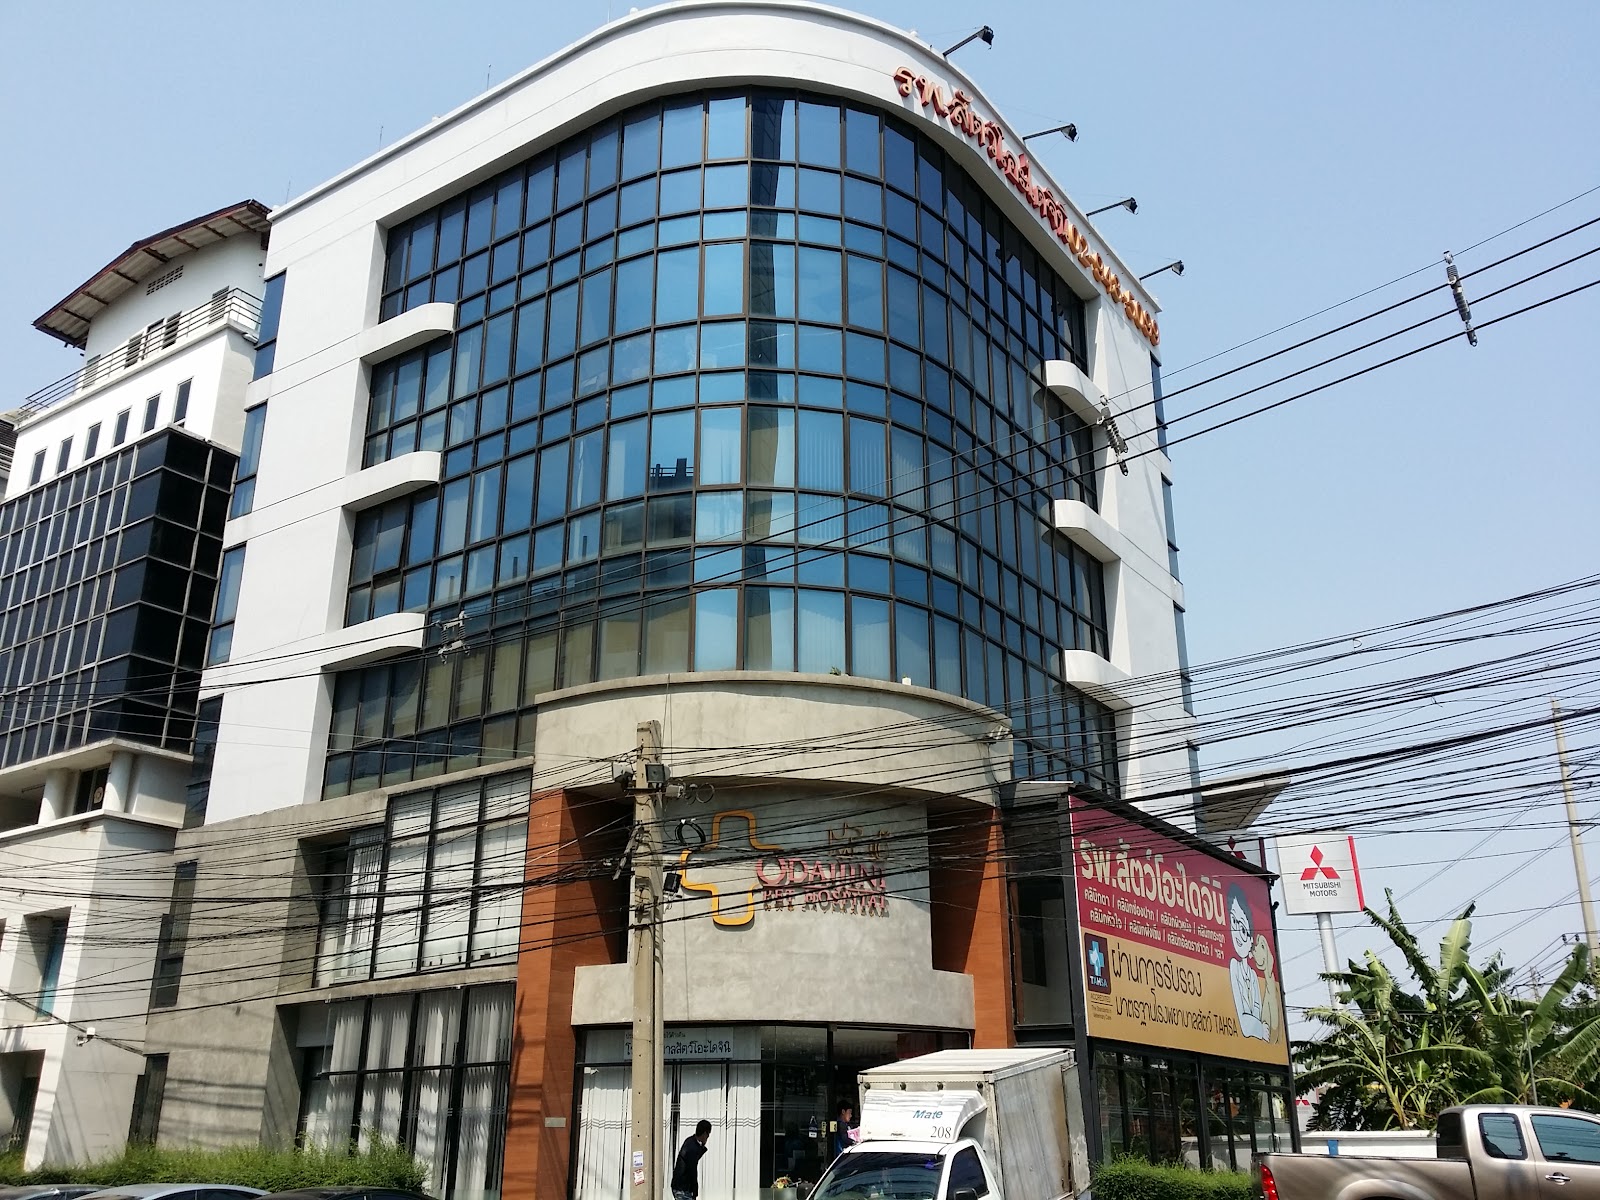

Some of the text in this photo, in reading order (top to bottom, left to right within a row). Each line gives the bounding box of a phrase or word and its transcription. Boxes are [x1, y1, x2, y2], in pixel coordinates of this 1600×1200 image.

[1079, 837, 1226, 926] รพ.สัตว์โอะไดจินิ
[1302, 881, 1342, 890] MITSUBISHI
[763, 889, 795, 903] PET
[1309, 889, 1338, 897] MOTORS
[1111, 942, 1202, 997] ผ่านการรับรอง
[1090, 975, 1108, 988] TAHSA
[1213, 1014, 1239, 1037] TAHSA
[912, 1109, 944, 1120] Mate
[930, 1126, 952, 1139] 208
